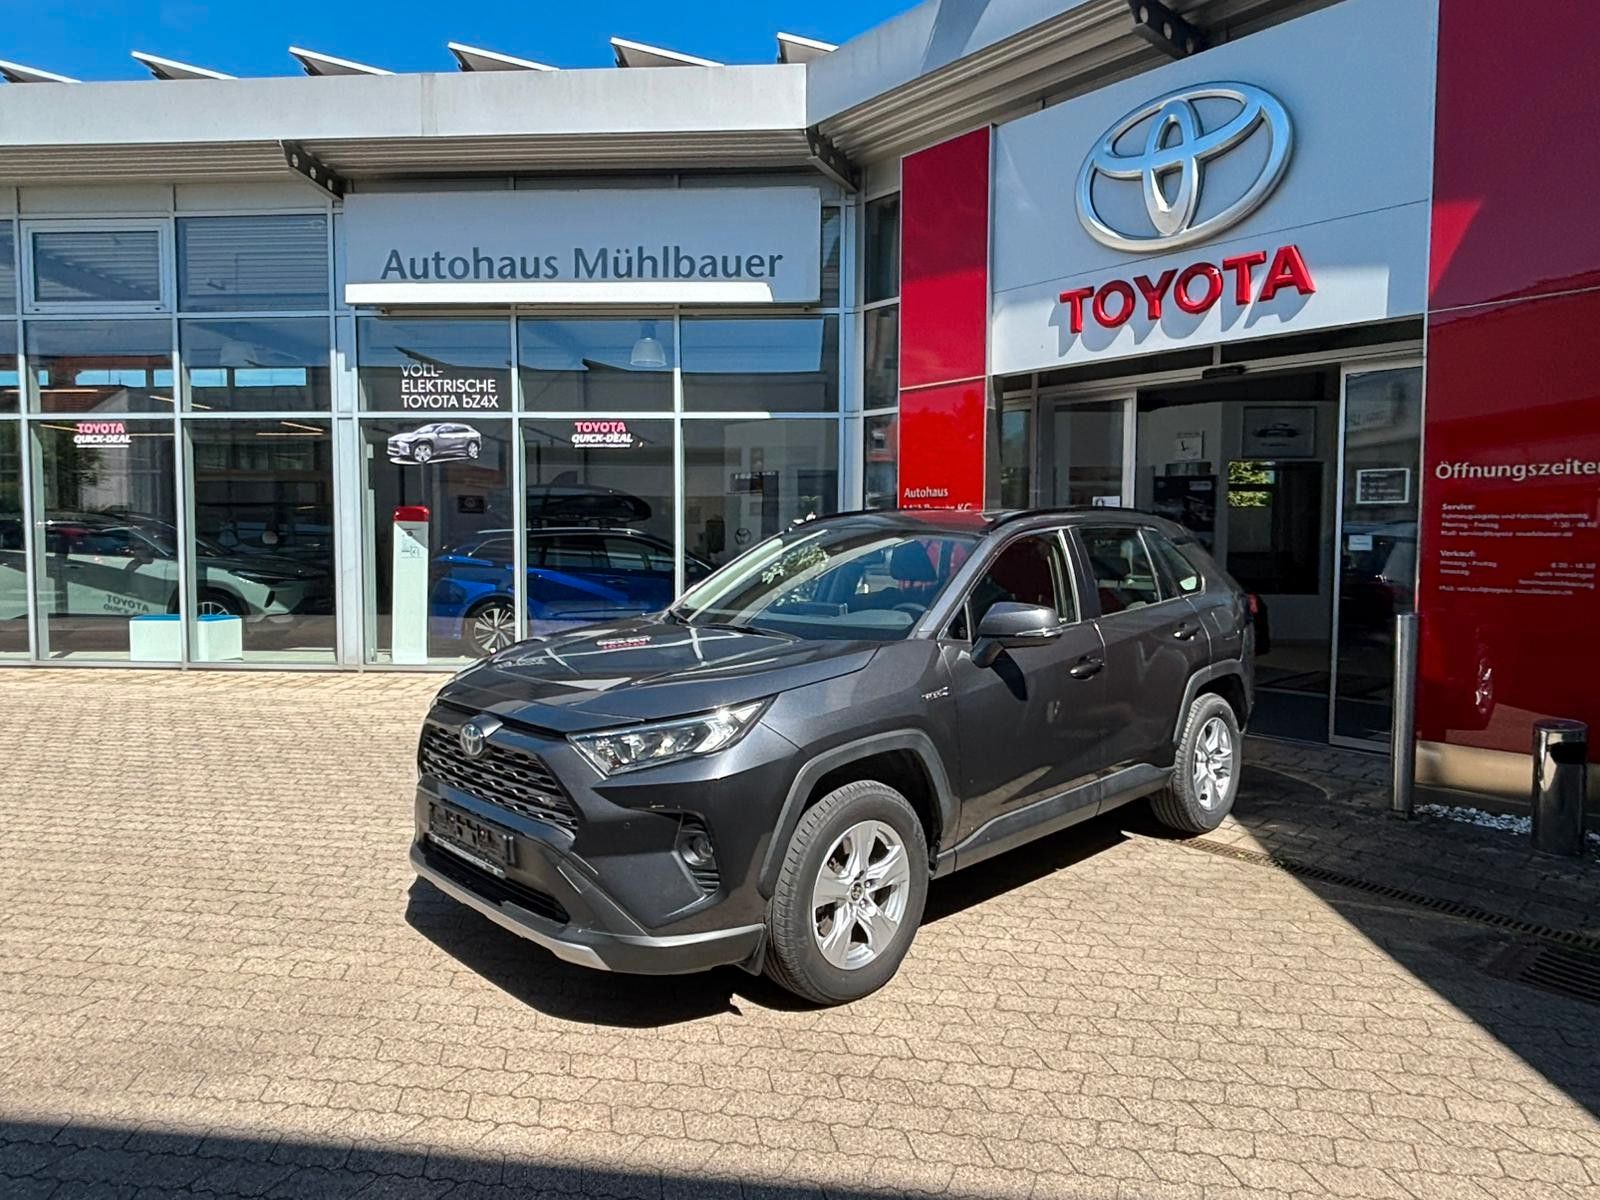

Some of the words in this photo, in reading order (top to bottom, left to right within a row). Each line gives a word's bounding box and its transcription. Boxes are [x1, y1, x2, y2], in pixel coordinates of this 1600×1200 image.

[380, 246, 559, 280] Autohaus
[574, 246, 784, 279] Mühlbauer
[1059, 244, 1316, 334] TOYOTA
[400, 363, 444, 377] VOLL-
[401, 379, 496, 393] ELEKTRISCHE
[401, 395, 458, 408] TOYOTA
[462, 394, 499, 408] bZ4X
[76, 423, 125, 433] TOYOTA
[574, 422, 626, 433] TOYOTA
[73, 434, 132, 444] QUICK-DEAL
[571, 433, 633, 443] QUICK-DEAL
[1435, 458, 1600, 482] Öffnungszeite
[904, 486, 948, 498] Autohaus
[105, 594, 150, 612] TOYOTA
